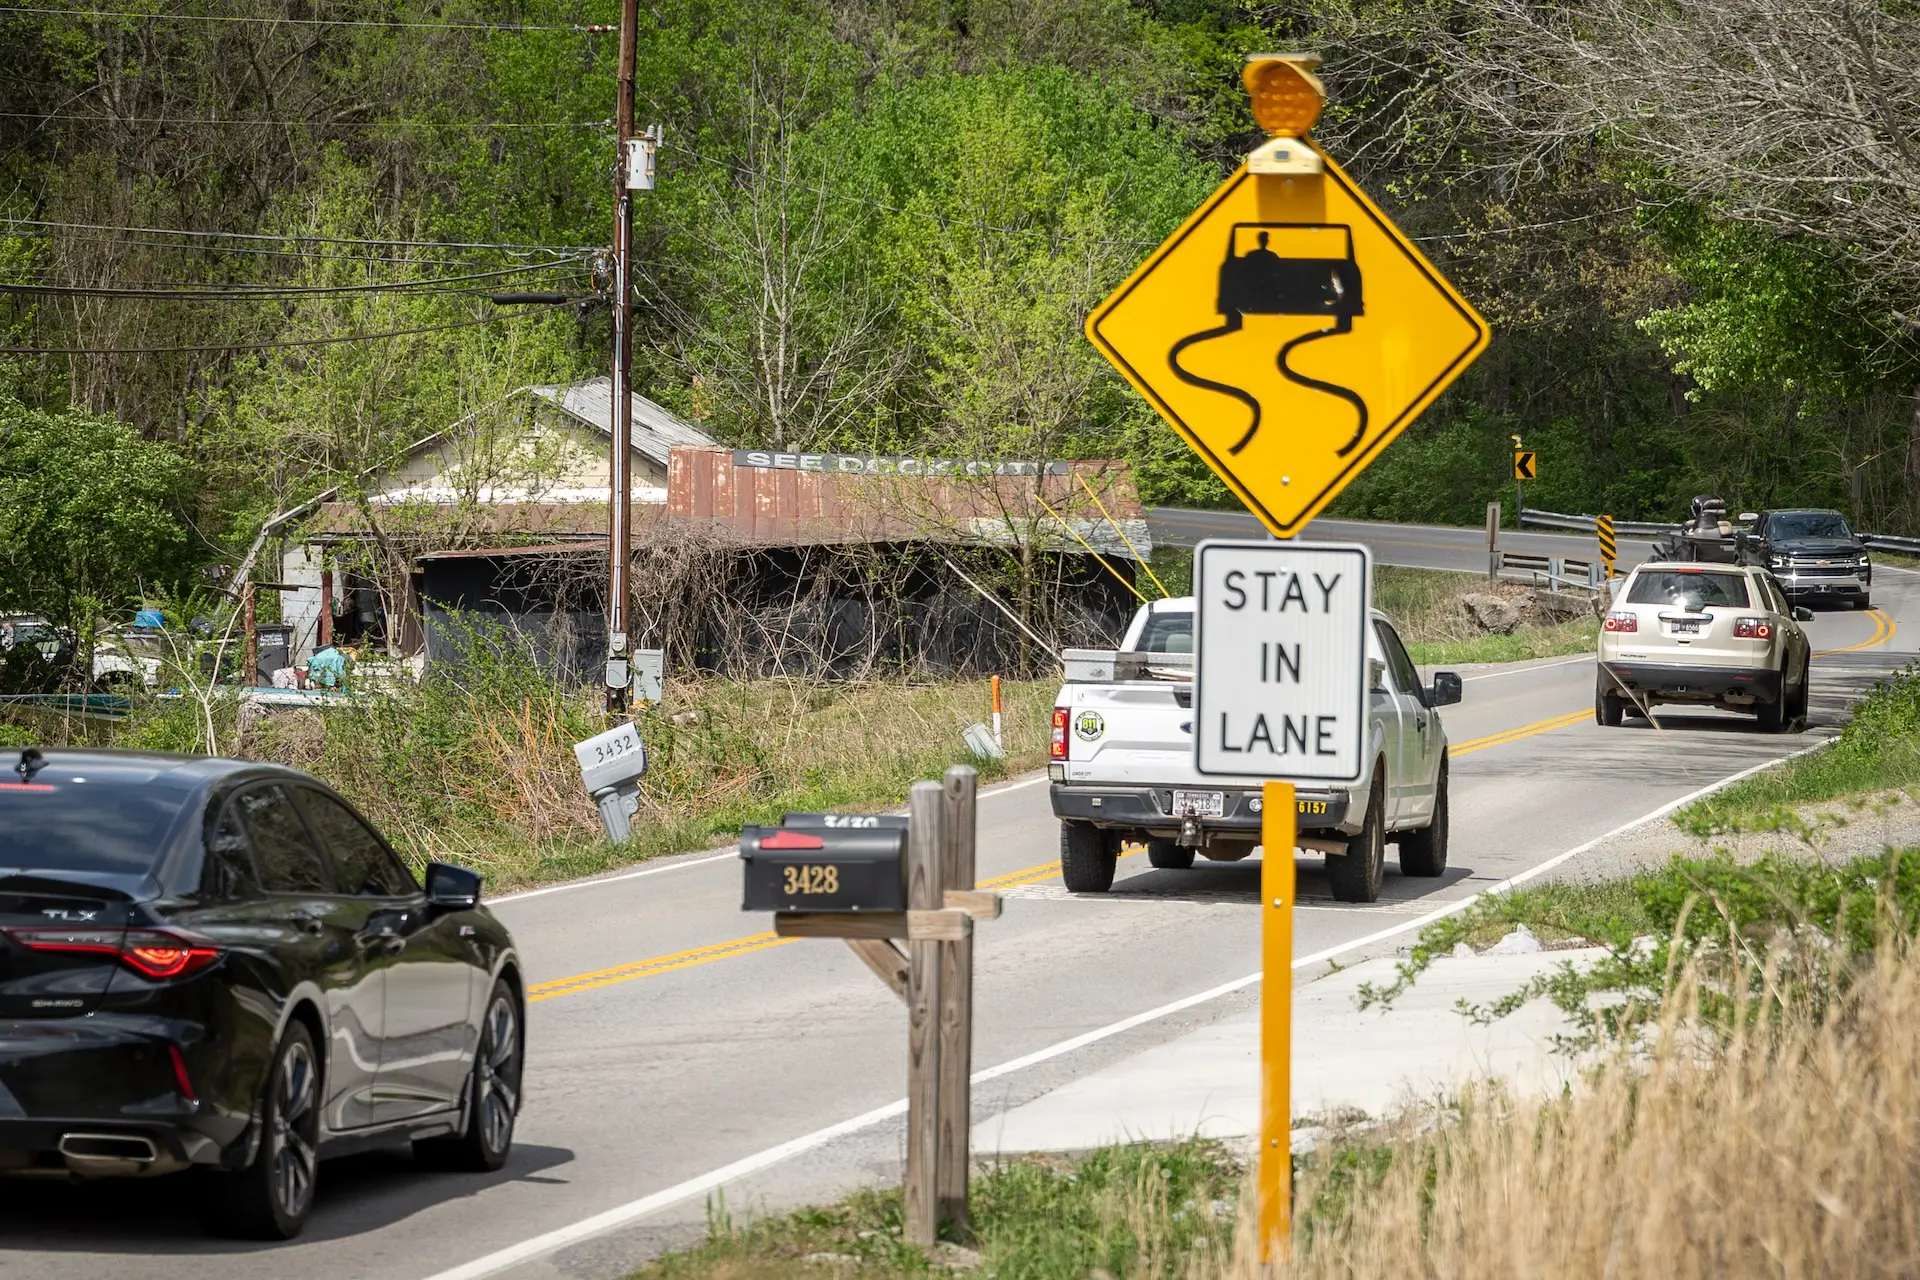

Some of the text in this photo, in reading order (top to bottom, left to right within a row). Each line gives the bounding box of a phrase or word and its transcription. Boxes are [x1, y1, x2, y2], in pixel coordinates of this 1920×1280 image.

[746, 452, 823, 470] SEE
[1222, 570, 1343, 614] STAY
[1260, 642, 1301, 684] IN
[1081, 717, 1098, 729] 811
[1220, 712, 1337, 756] LANE
[594, 735, 633, 763] 3432
[1298, 801, 1328, 814] 6157
[783, 864, 840, 895] 3428
[41, 908, 98, 922] TLX
